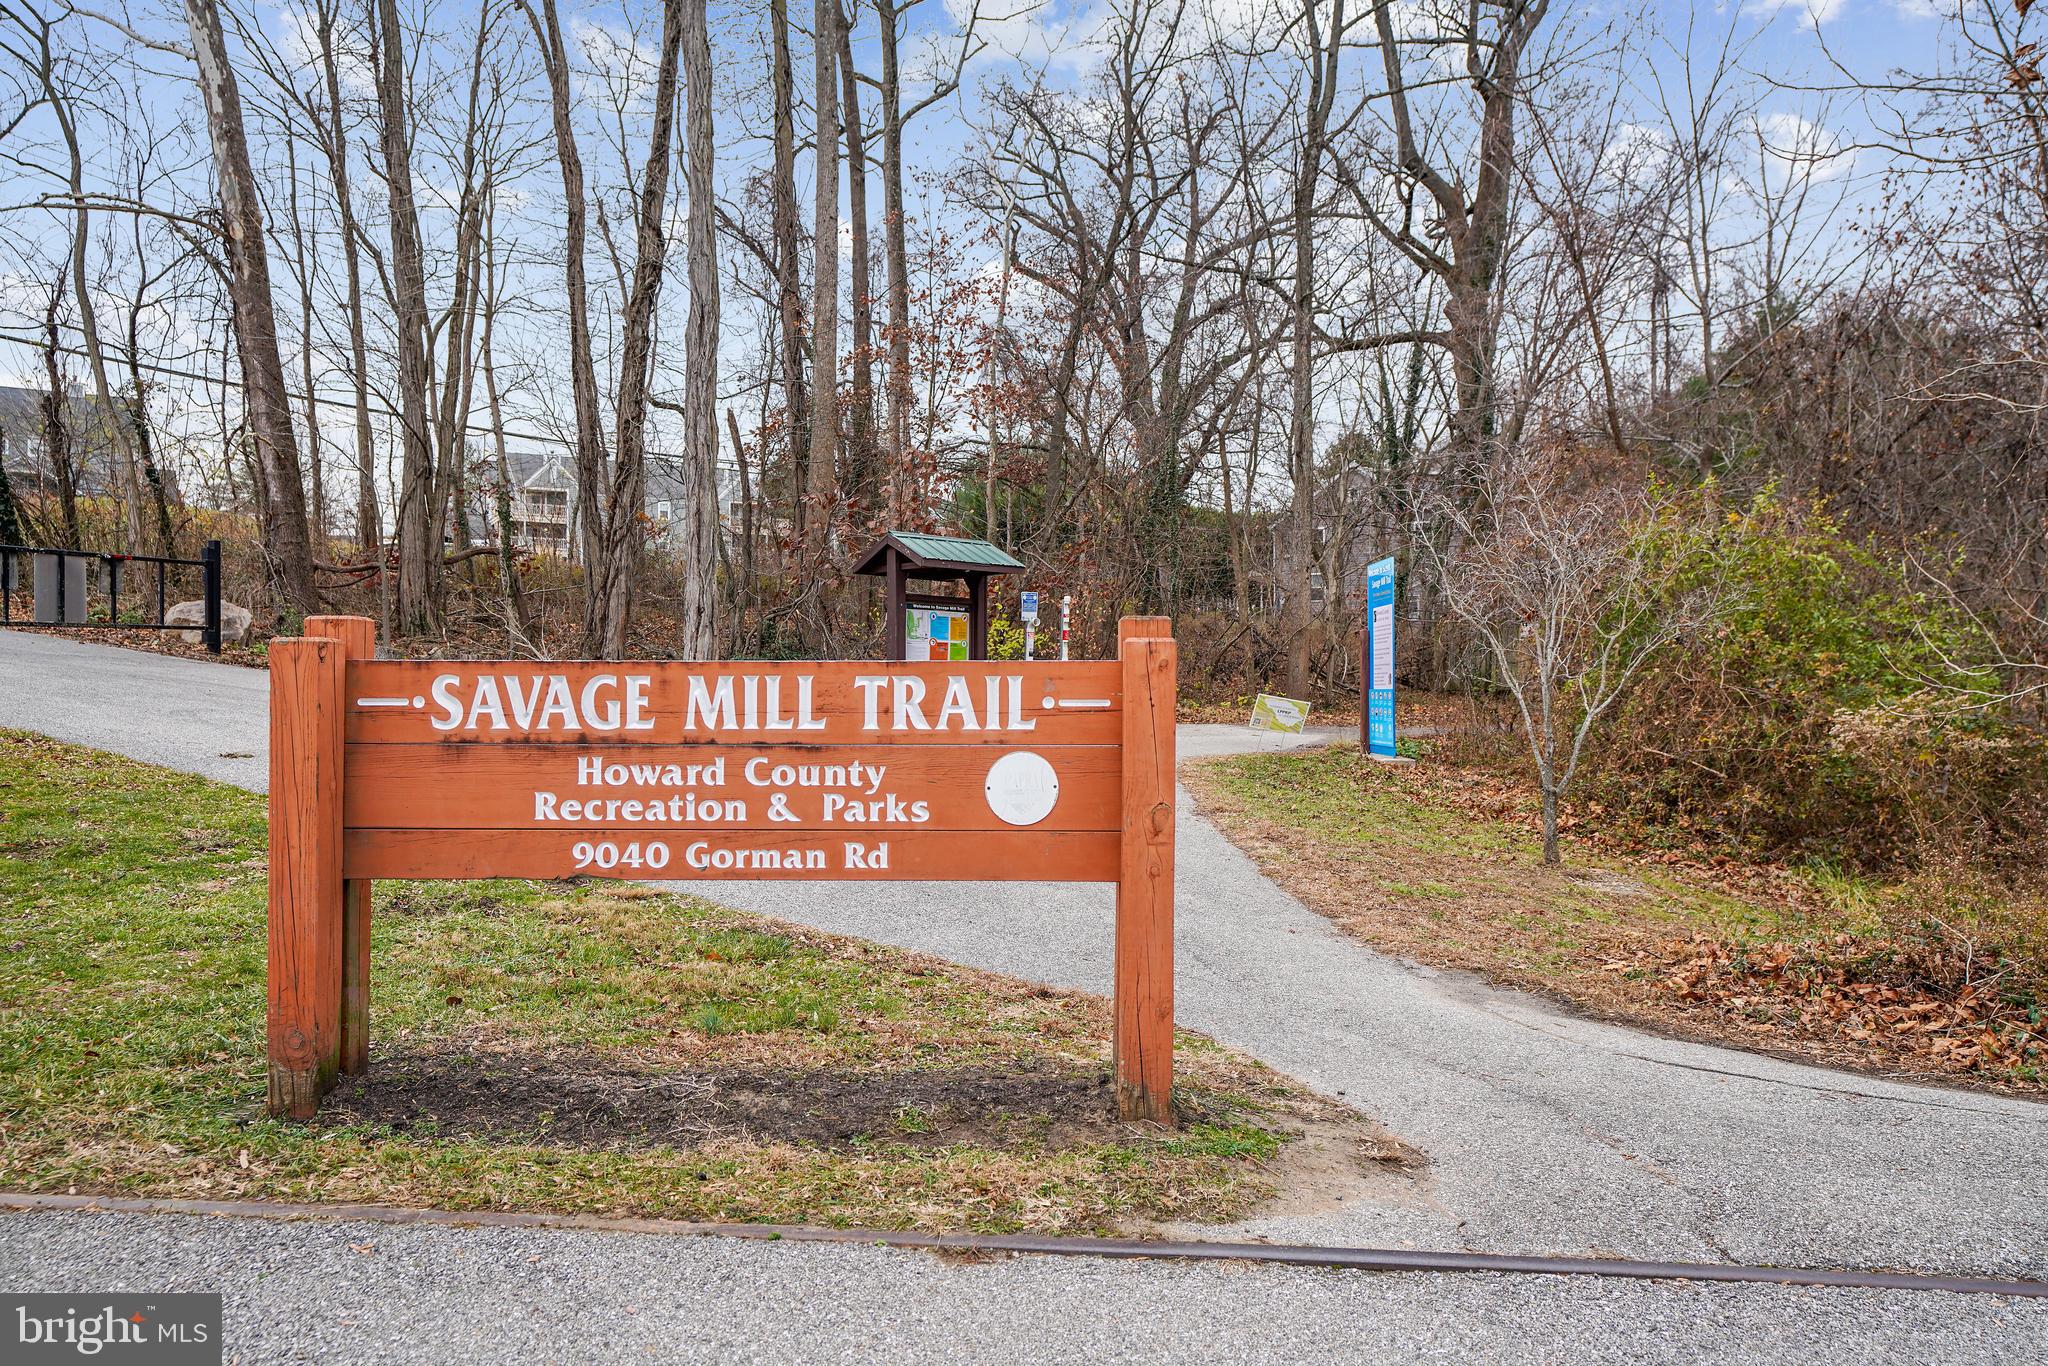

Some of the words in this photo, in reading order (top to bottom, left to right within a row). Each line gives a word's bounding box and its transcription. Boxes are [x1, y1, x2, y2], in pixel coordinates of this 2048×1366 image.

[430, 674, 656, 731] SAVAGE
[684, 675, 828, 731] MILL
[854, 675, 1037, 731] TRAIL
[577, 756, 726, 787] Howard
[744, 756, 887, 795] County
[534, 791, 748, 822] Recreation
[767, 792, 802, 823] &
[822, 792, 931, 823] Parks
[572, 842, 671, 870] 9040
[685, 842, 827, 870] Gorman
[843, 841, 889, 870] Rd
